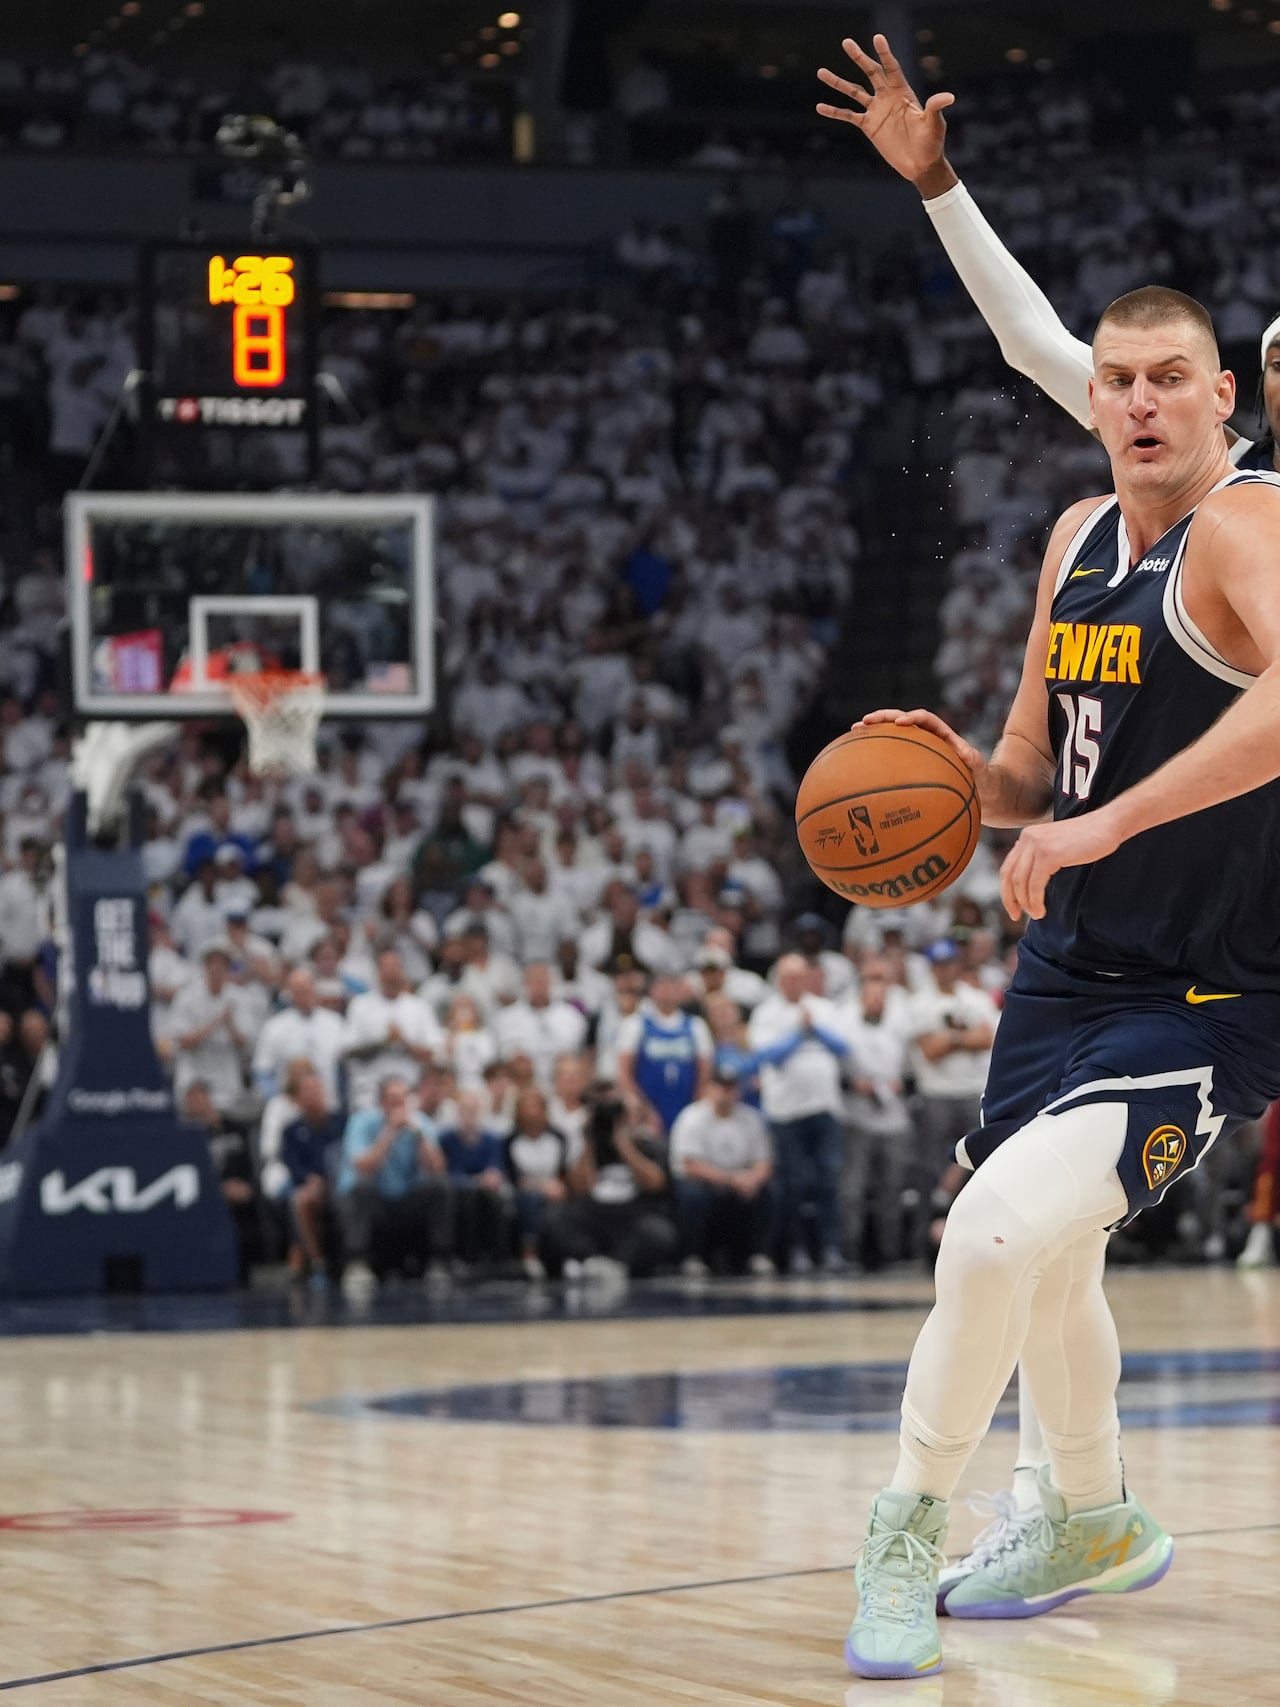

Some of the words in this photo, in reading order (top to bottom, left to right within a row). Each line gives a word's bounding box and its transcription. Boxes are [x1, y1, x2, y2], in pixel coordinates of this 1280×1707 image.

[233, 304, 285, 387] 8
[1056, 692, 1102, 800] 15
[830, 854, 951, 899] Wilson
